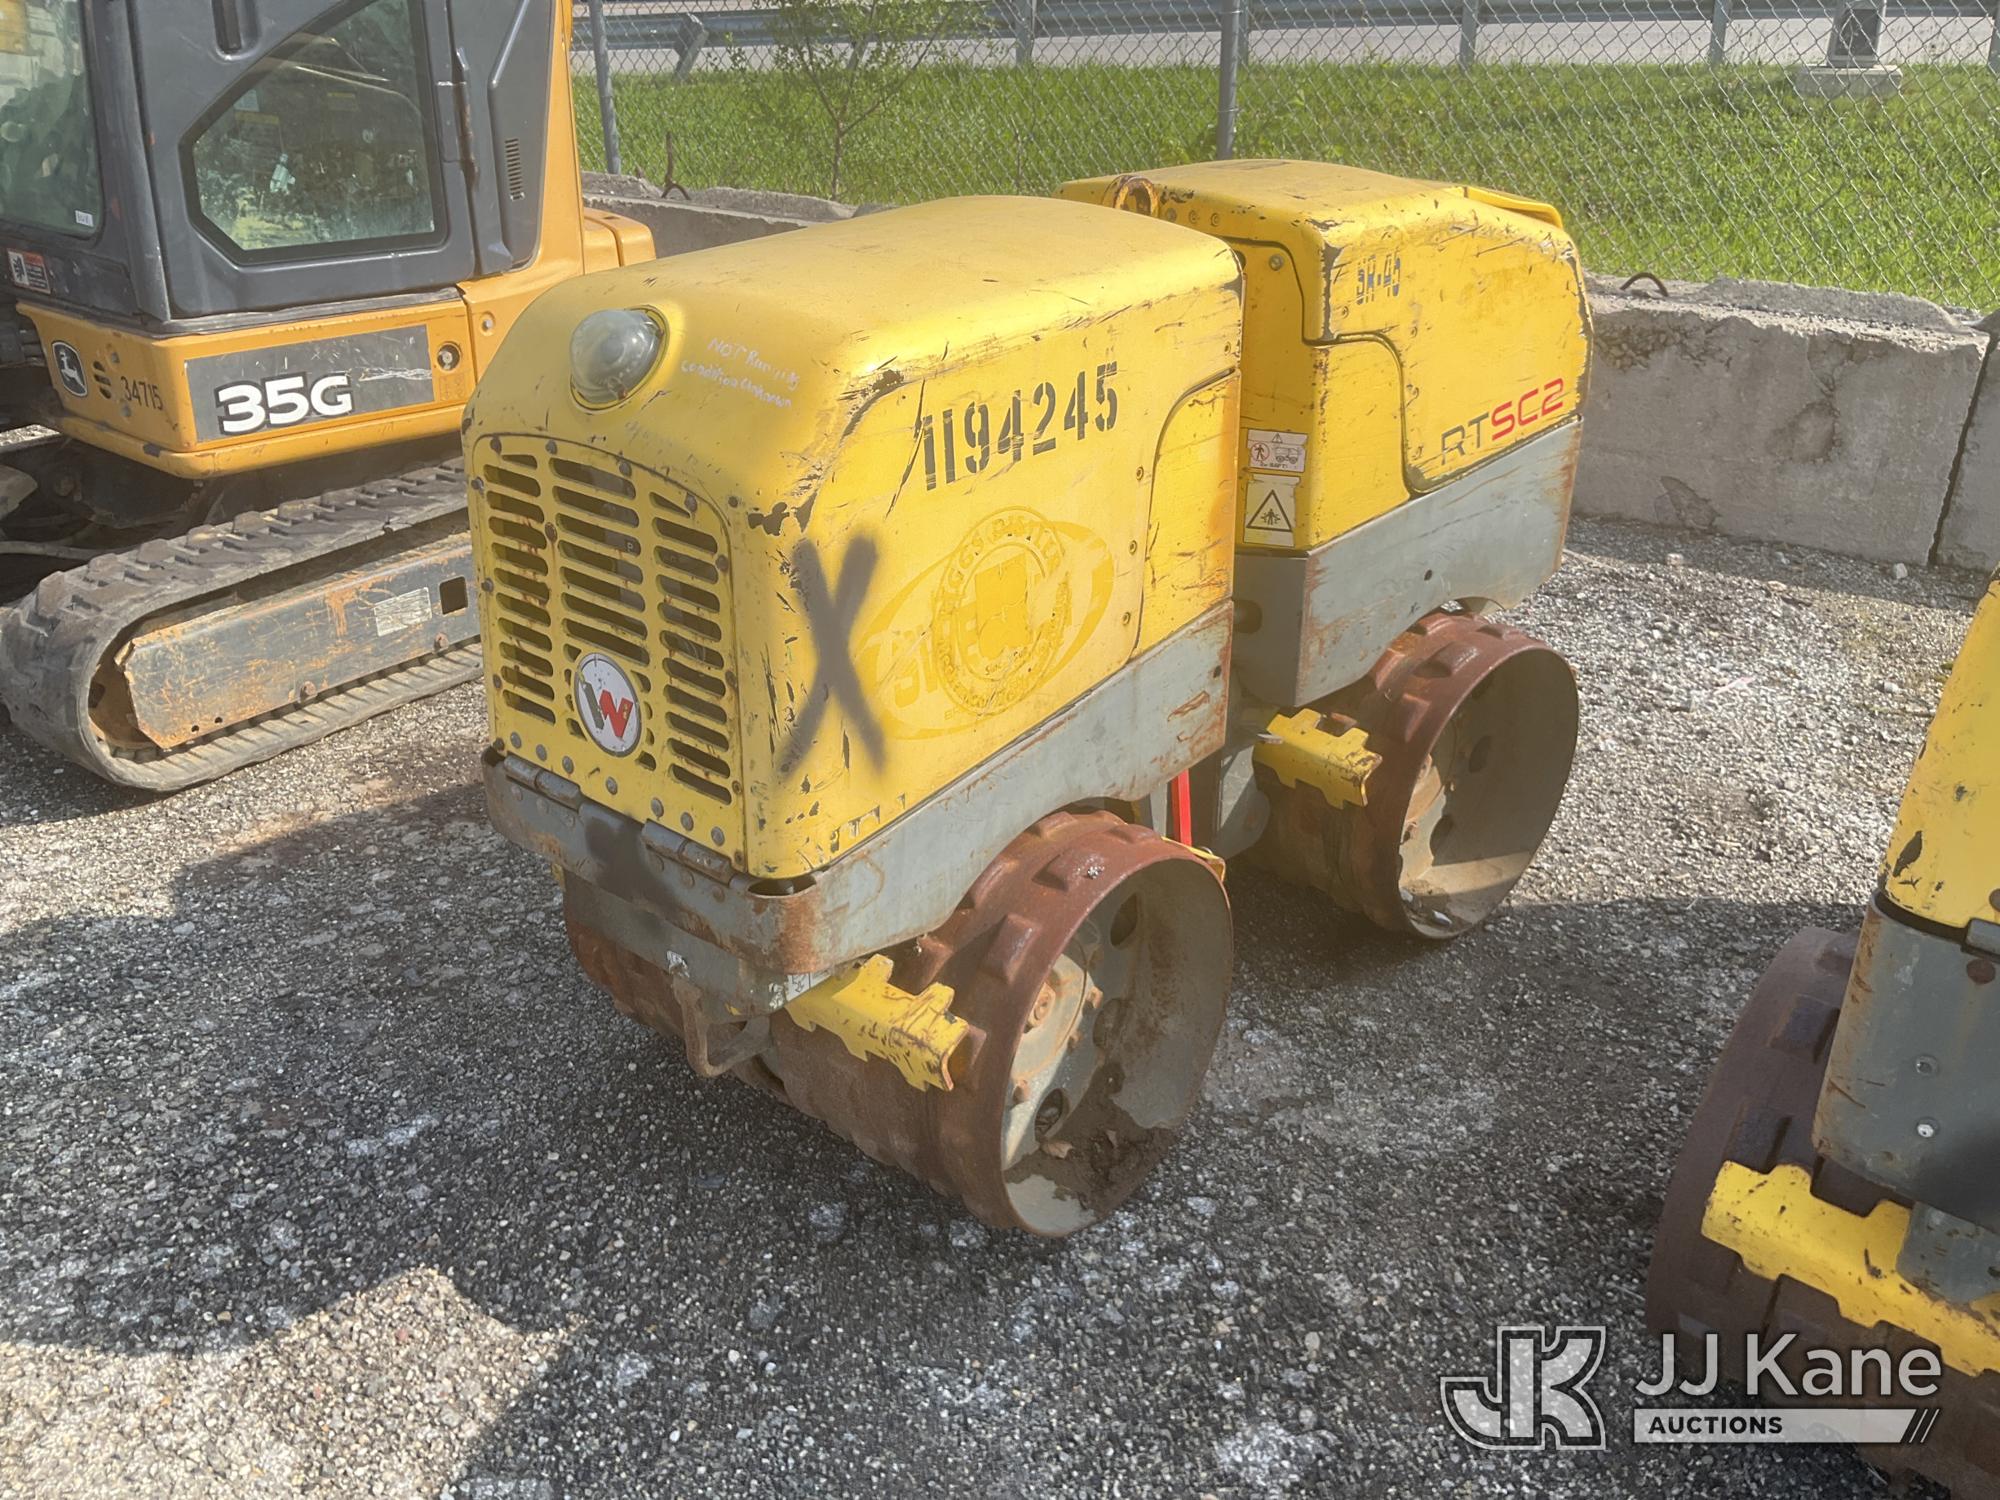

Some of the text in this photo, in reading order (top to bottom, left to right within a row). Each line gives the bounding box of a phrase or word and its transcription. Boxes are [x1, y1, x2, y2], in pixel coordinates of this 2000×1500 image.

[706, 338, 748, 361] NOT
[120, 375, 164, 411] 34715
[217, 374, 353, 434] 35G
[919, 361, 1118, 491] 1194245
